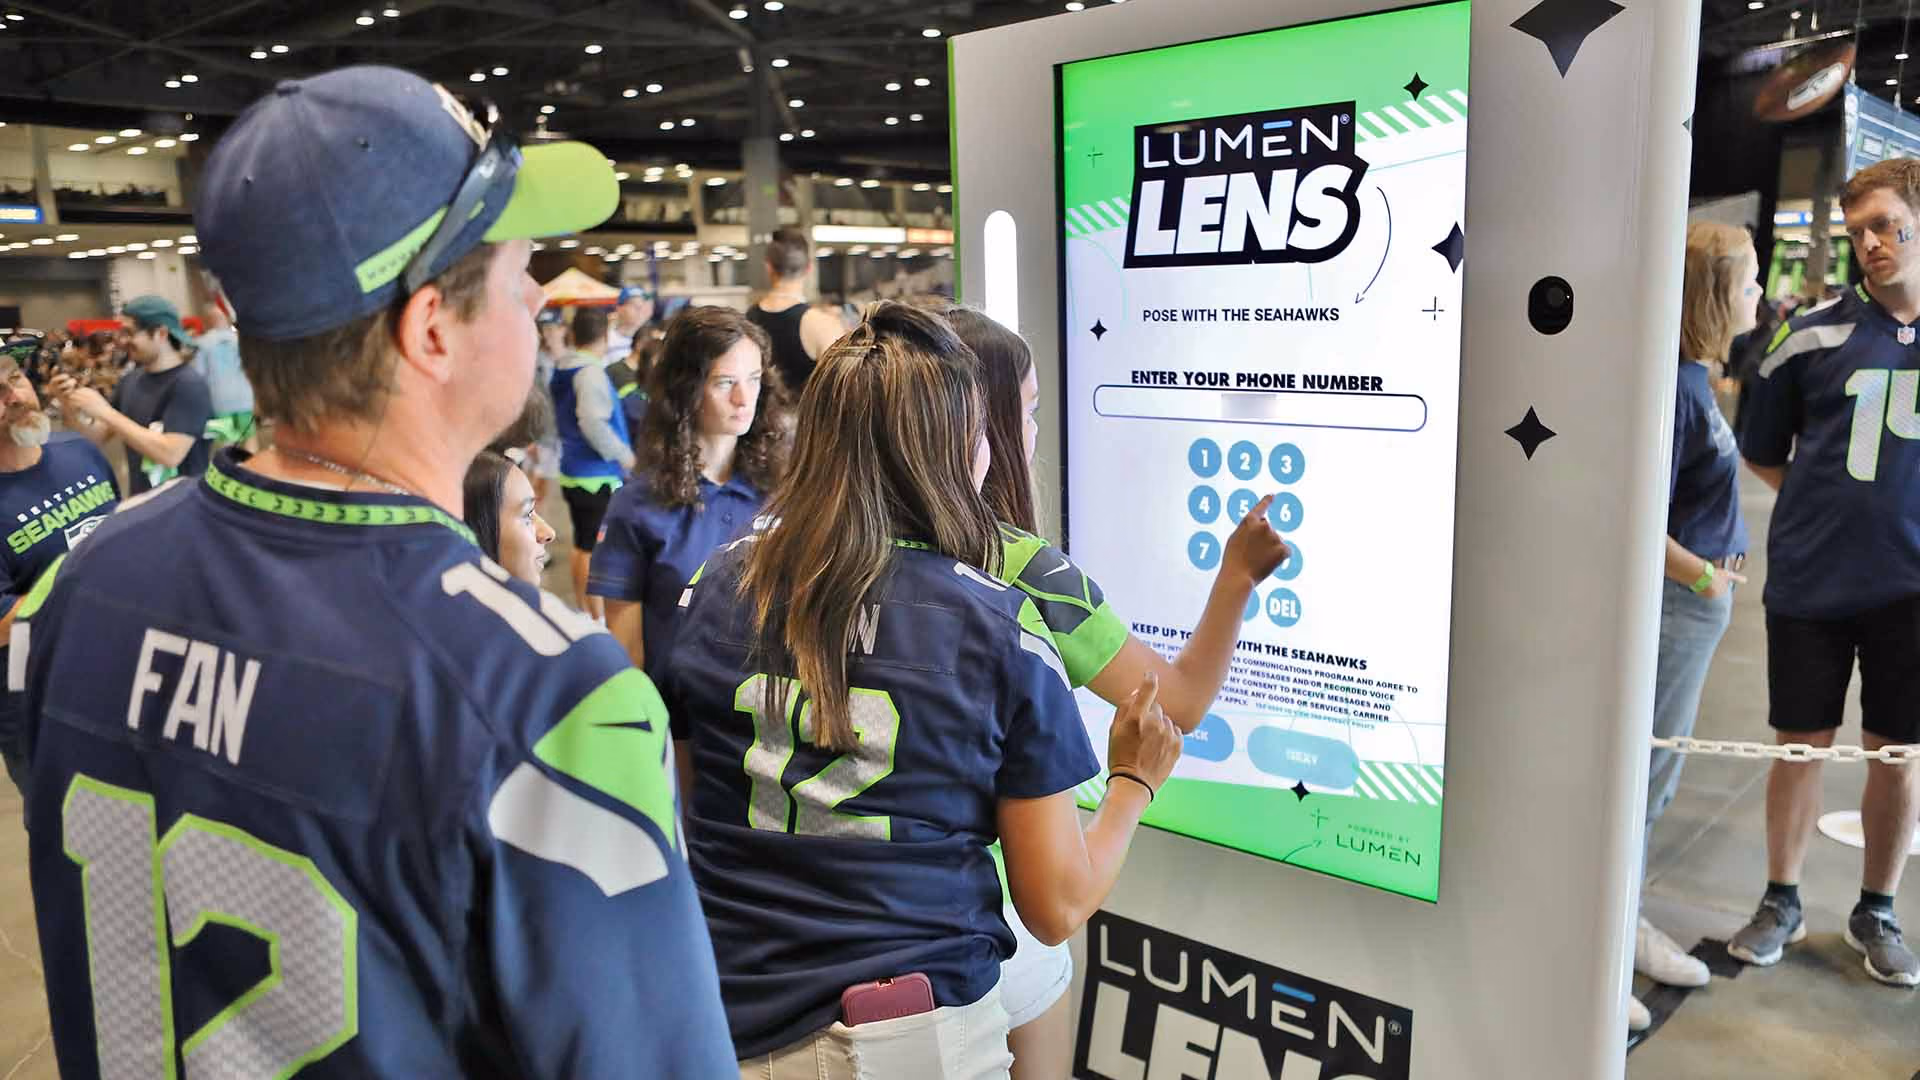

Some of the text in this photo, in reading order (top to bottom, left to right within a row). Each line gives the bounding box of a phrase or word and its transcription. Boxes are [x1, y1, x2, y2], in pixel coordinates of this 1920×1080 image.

[1133, 163, 1354, 257] LENS
[1142, 307, 1340, 323] POSE WITH THE SEAHAWKS
[1131, 370, 1383, 392] ENTER YOUR PHONE NUMBER
[1201, 448, 1293, 475] 1 2 3
[1198, 496, 1292, 523] 4 5 6
[1199, 542, 1210, 560] 7
[1269, 597, 1299, 619] DEL
[1131, 621, 1159, 635] KEEP
[1161, 627, 1178, 638] UP
[1265, 644, 1289, 658] THE
[1291, 648, 1368, 671] SEAHAWKS
[1229, 675, 1391, 712] MY CONSENT TO RECEIVE MESSAGES AND
[1230, 665, 1396, 702] TEXT MESSAGES AND/OR RECORDED VOICE
[1242, 657, 1313, 675] COMMUNICATIONS
[1314, 669, 1354, 683] PROGRAM
[1356, 677, 1374, 687] AND
[1376, 680, 1404, 692] AGREE
[1407, 685, 1418, 694] TO
[127, 627, 261, 766] FAN
[1251, 690, 1266, 700] ANY
[1268, 693, 1295, 706] GOODS
[1296, 699, 1308, 708] OR
[1352, 709, 1389, 723] CARRIER
[734, 672, 901, 842] 12
[1336, 832, 1421, 867] LUMEN
[62, 772, 358, 1080] 12
[1086, 980, 1381, 1080] LEN
